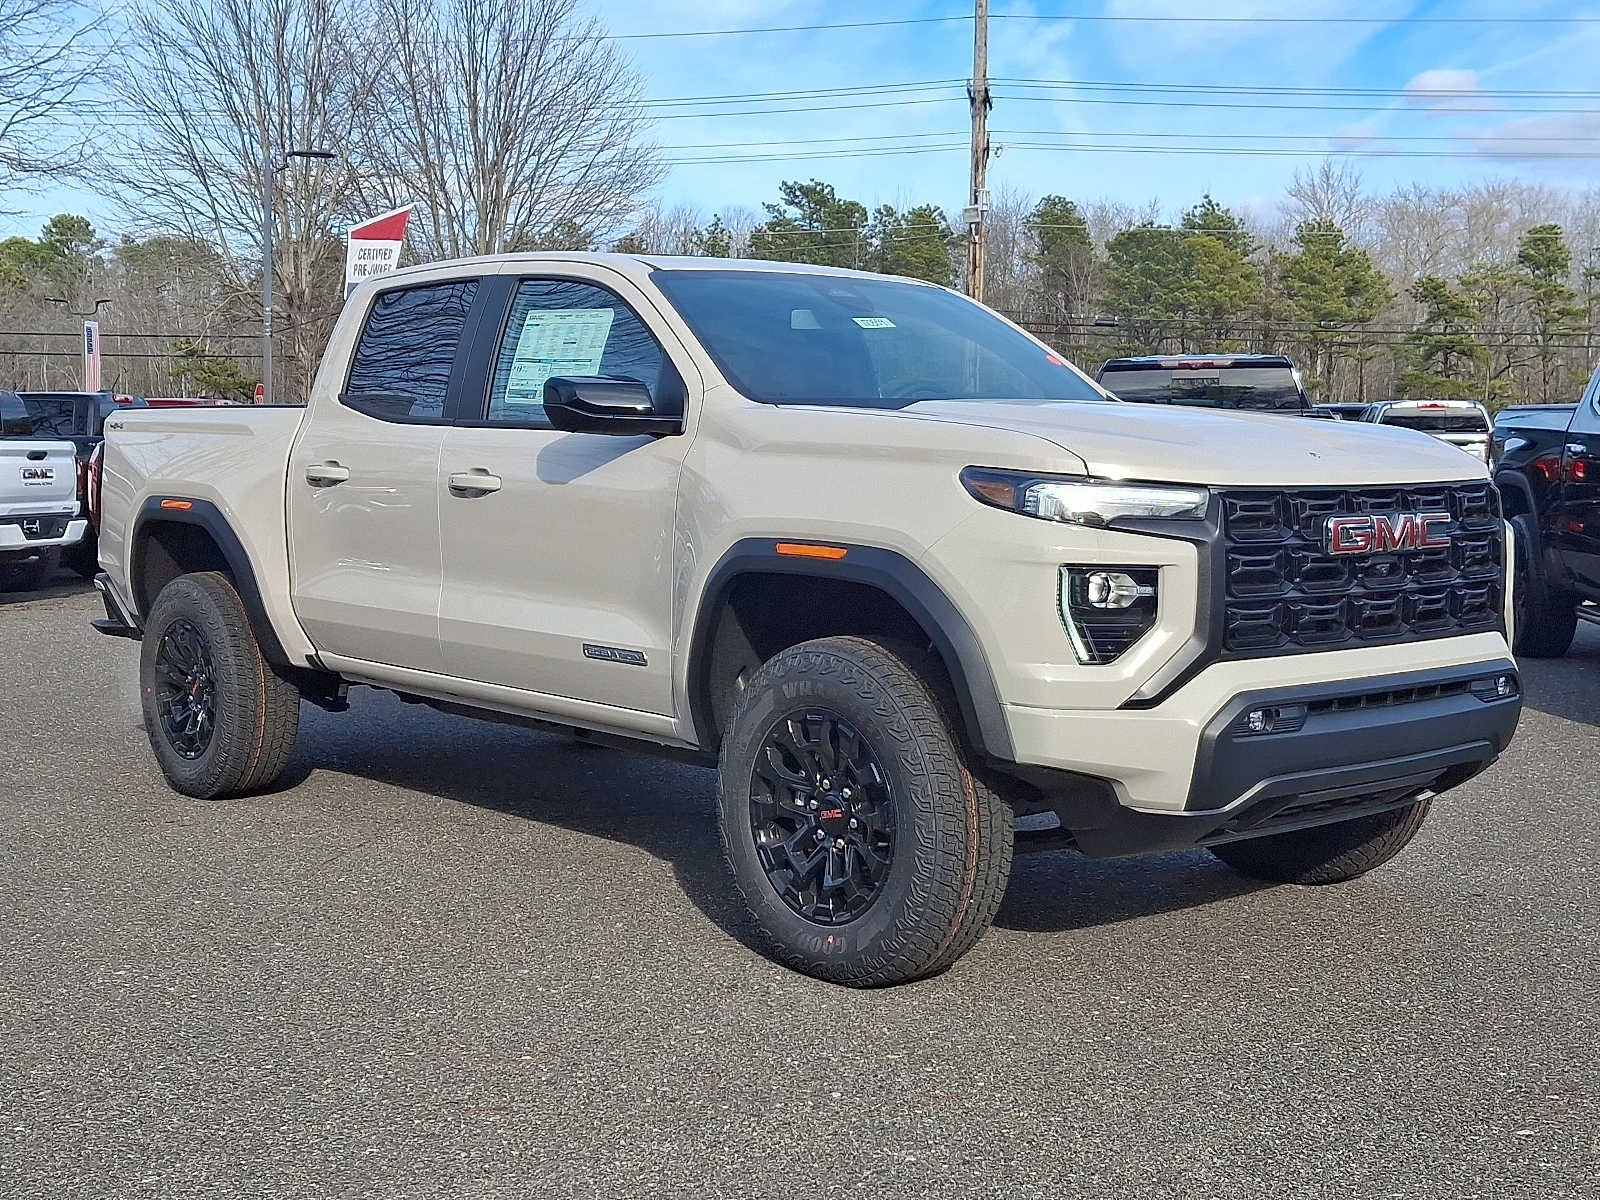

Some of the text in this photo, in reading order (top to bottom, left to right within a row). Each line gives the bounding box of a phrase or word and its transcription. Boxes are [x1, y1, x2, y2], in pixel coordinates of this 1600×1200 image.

[358, 248, 393, 261] CERTIFIED
[22, 468, 54, 479] GMC
[1328, 513, 1451, 555] GMC
[820, 809, 843, 819] GMC
